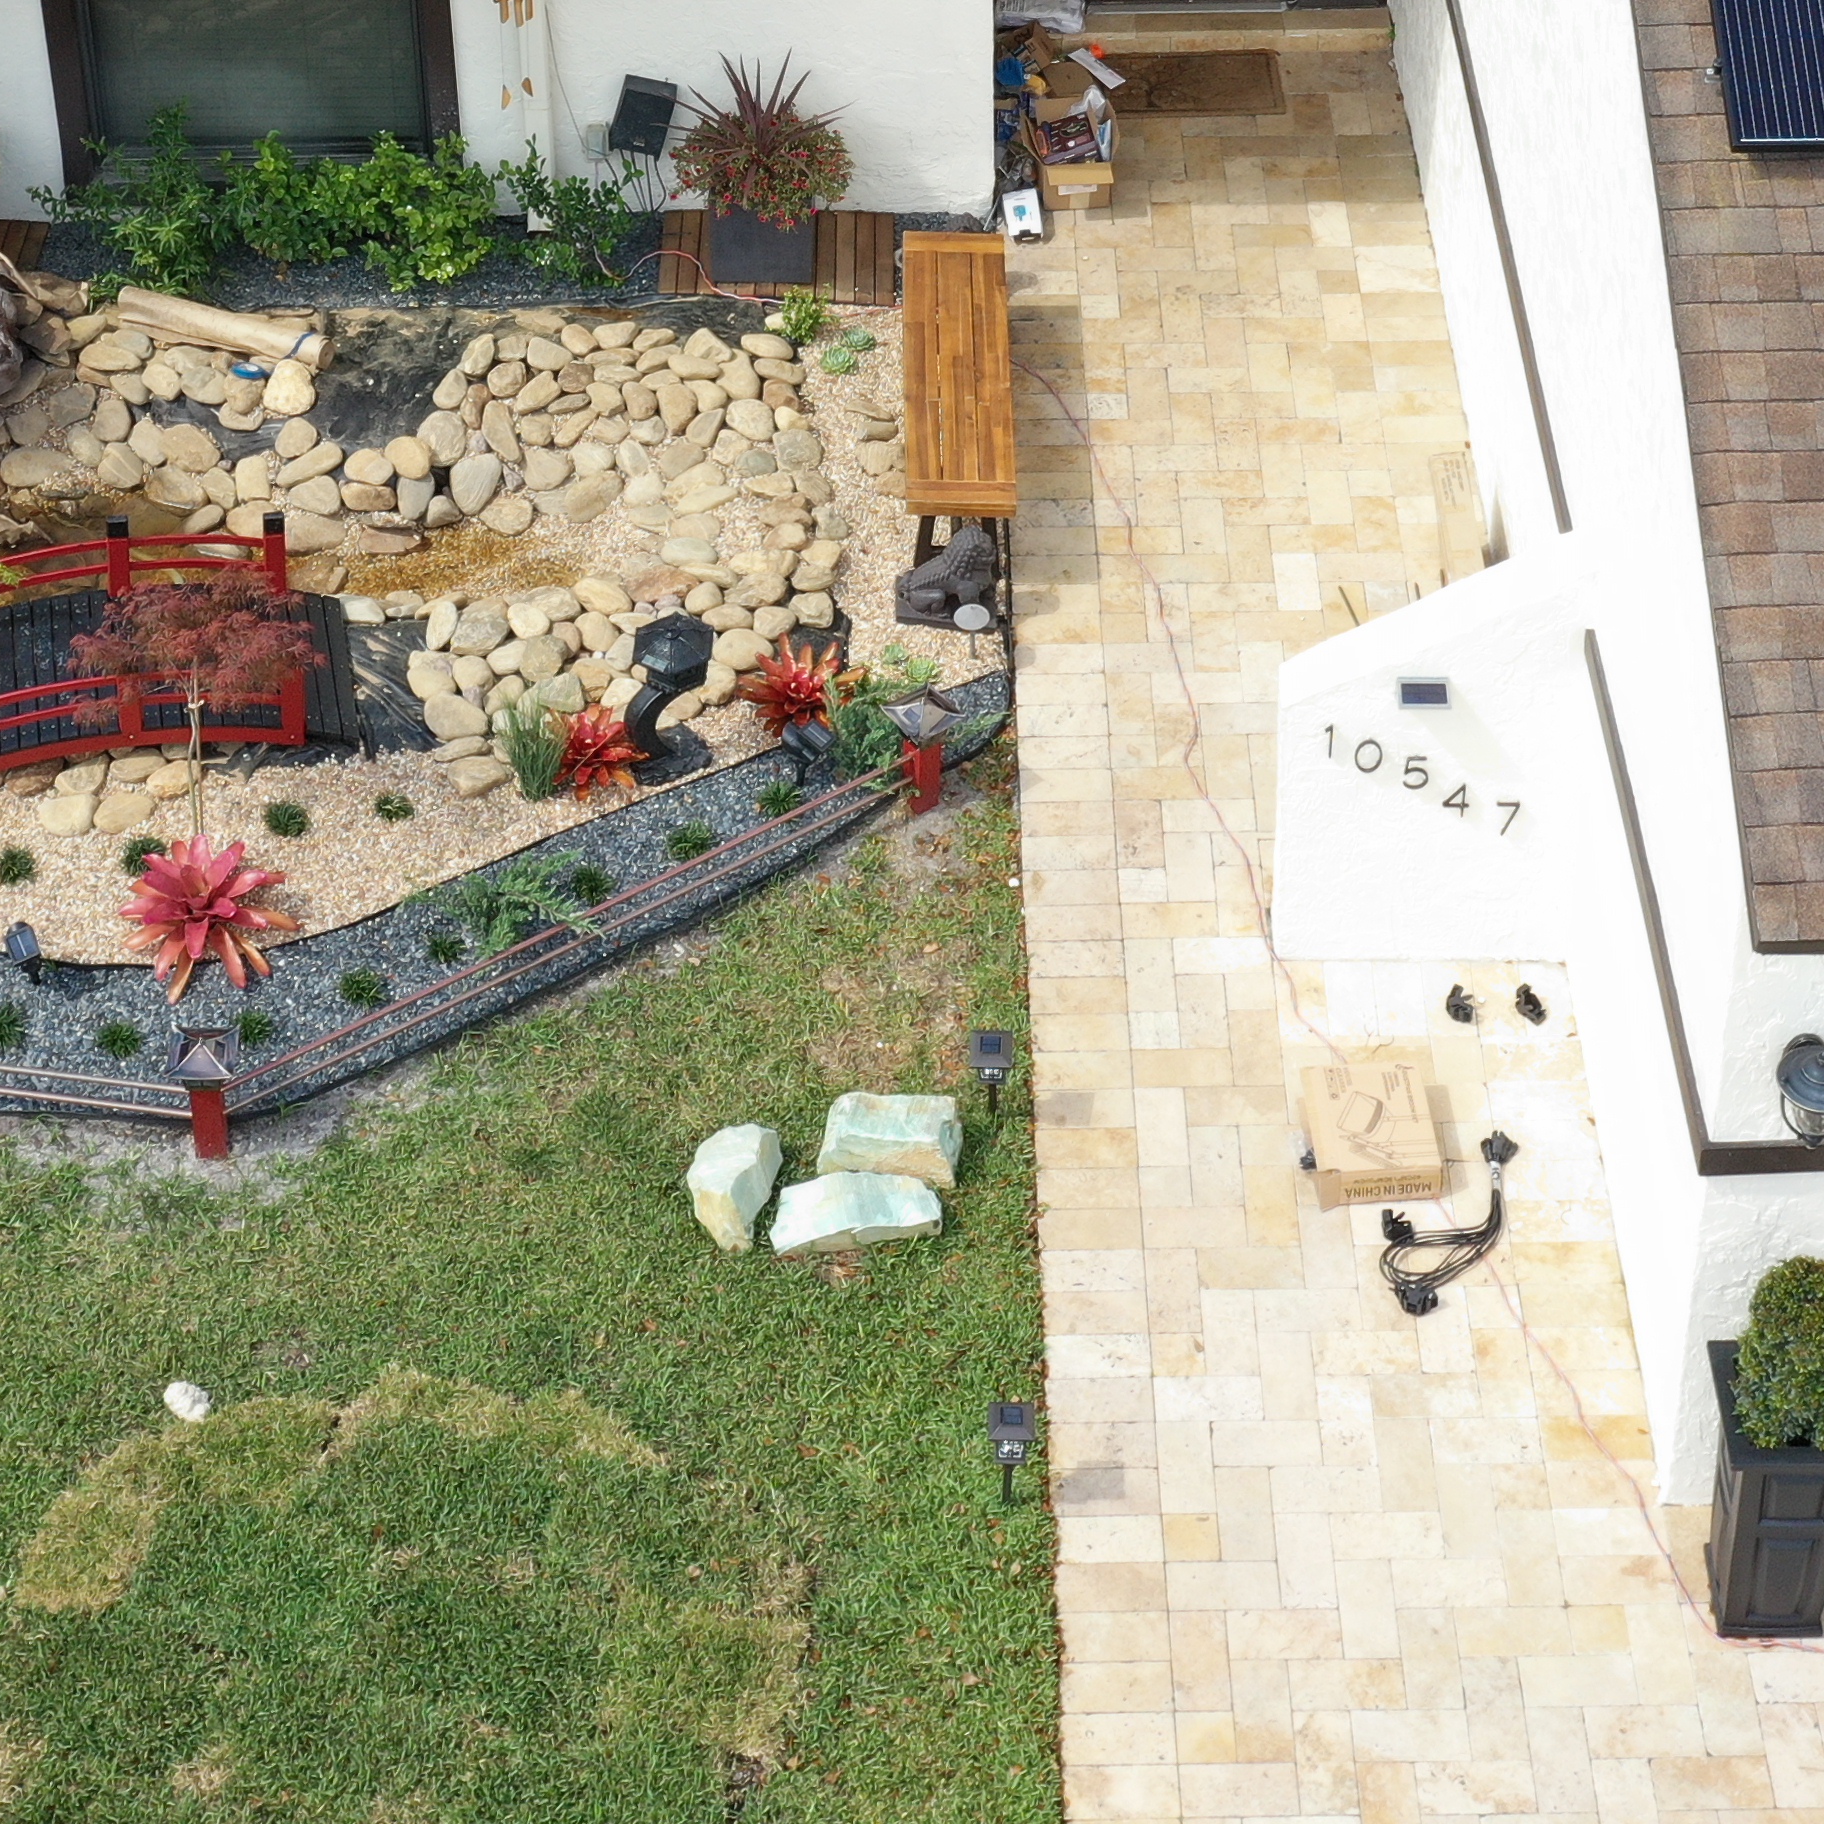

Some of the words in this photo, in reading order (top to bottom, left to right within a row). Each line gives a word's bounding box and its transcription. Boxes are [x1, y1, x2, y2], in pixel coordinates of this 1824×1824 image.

[1324, 723, 1521, 836] 10547
[1344, 1186, 1382, 1199] CHINA
[1383, 1185, 1396, 1196] IN
[1398, 1181, 1432, 1195] MADE
